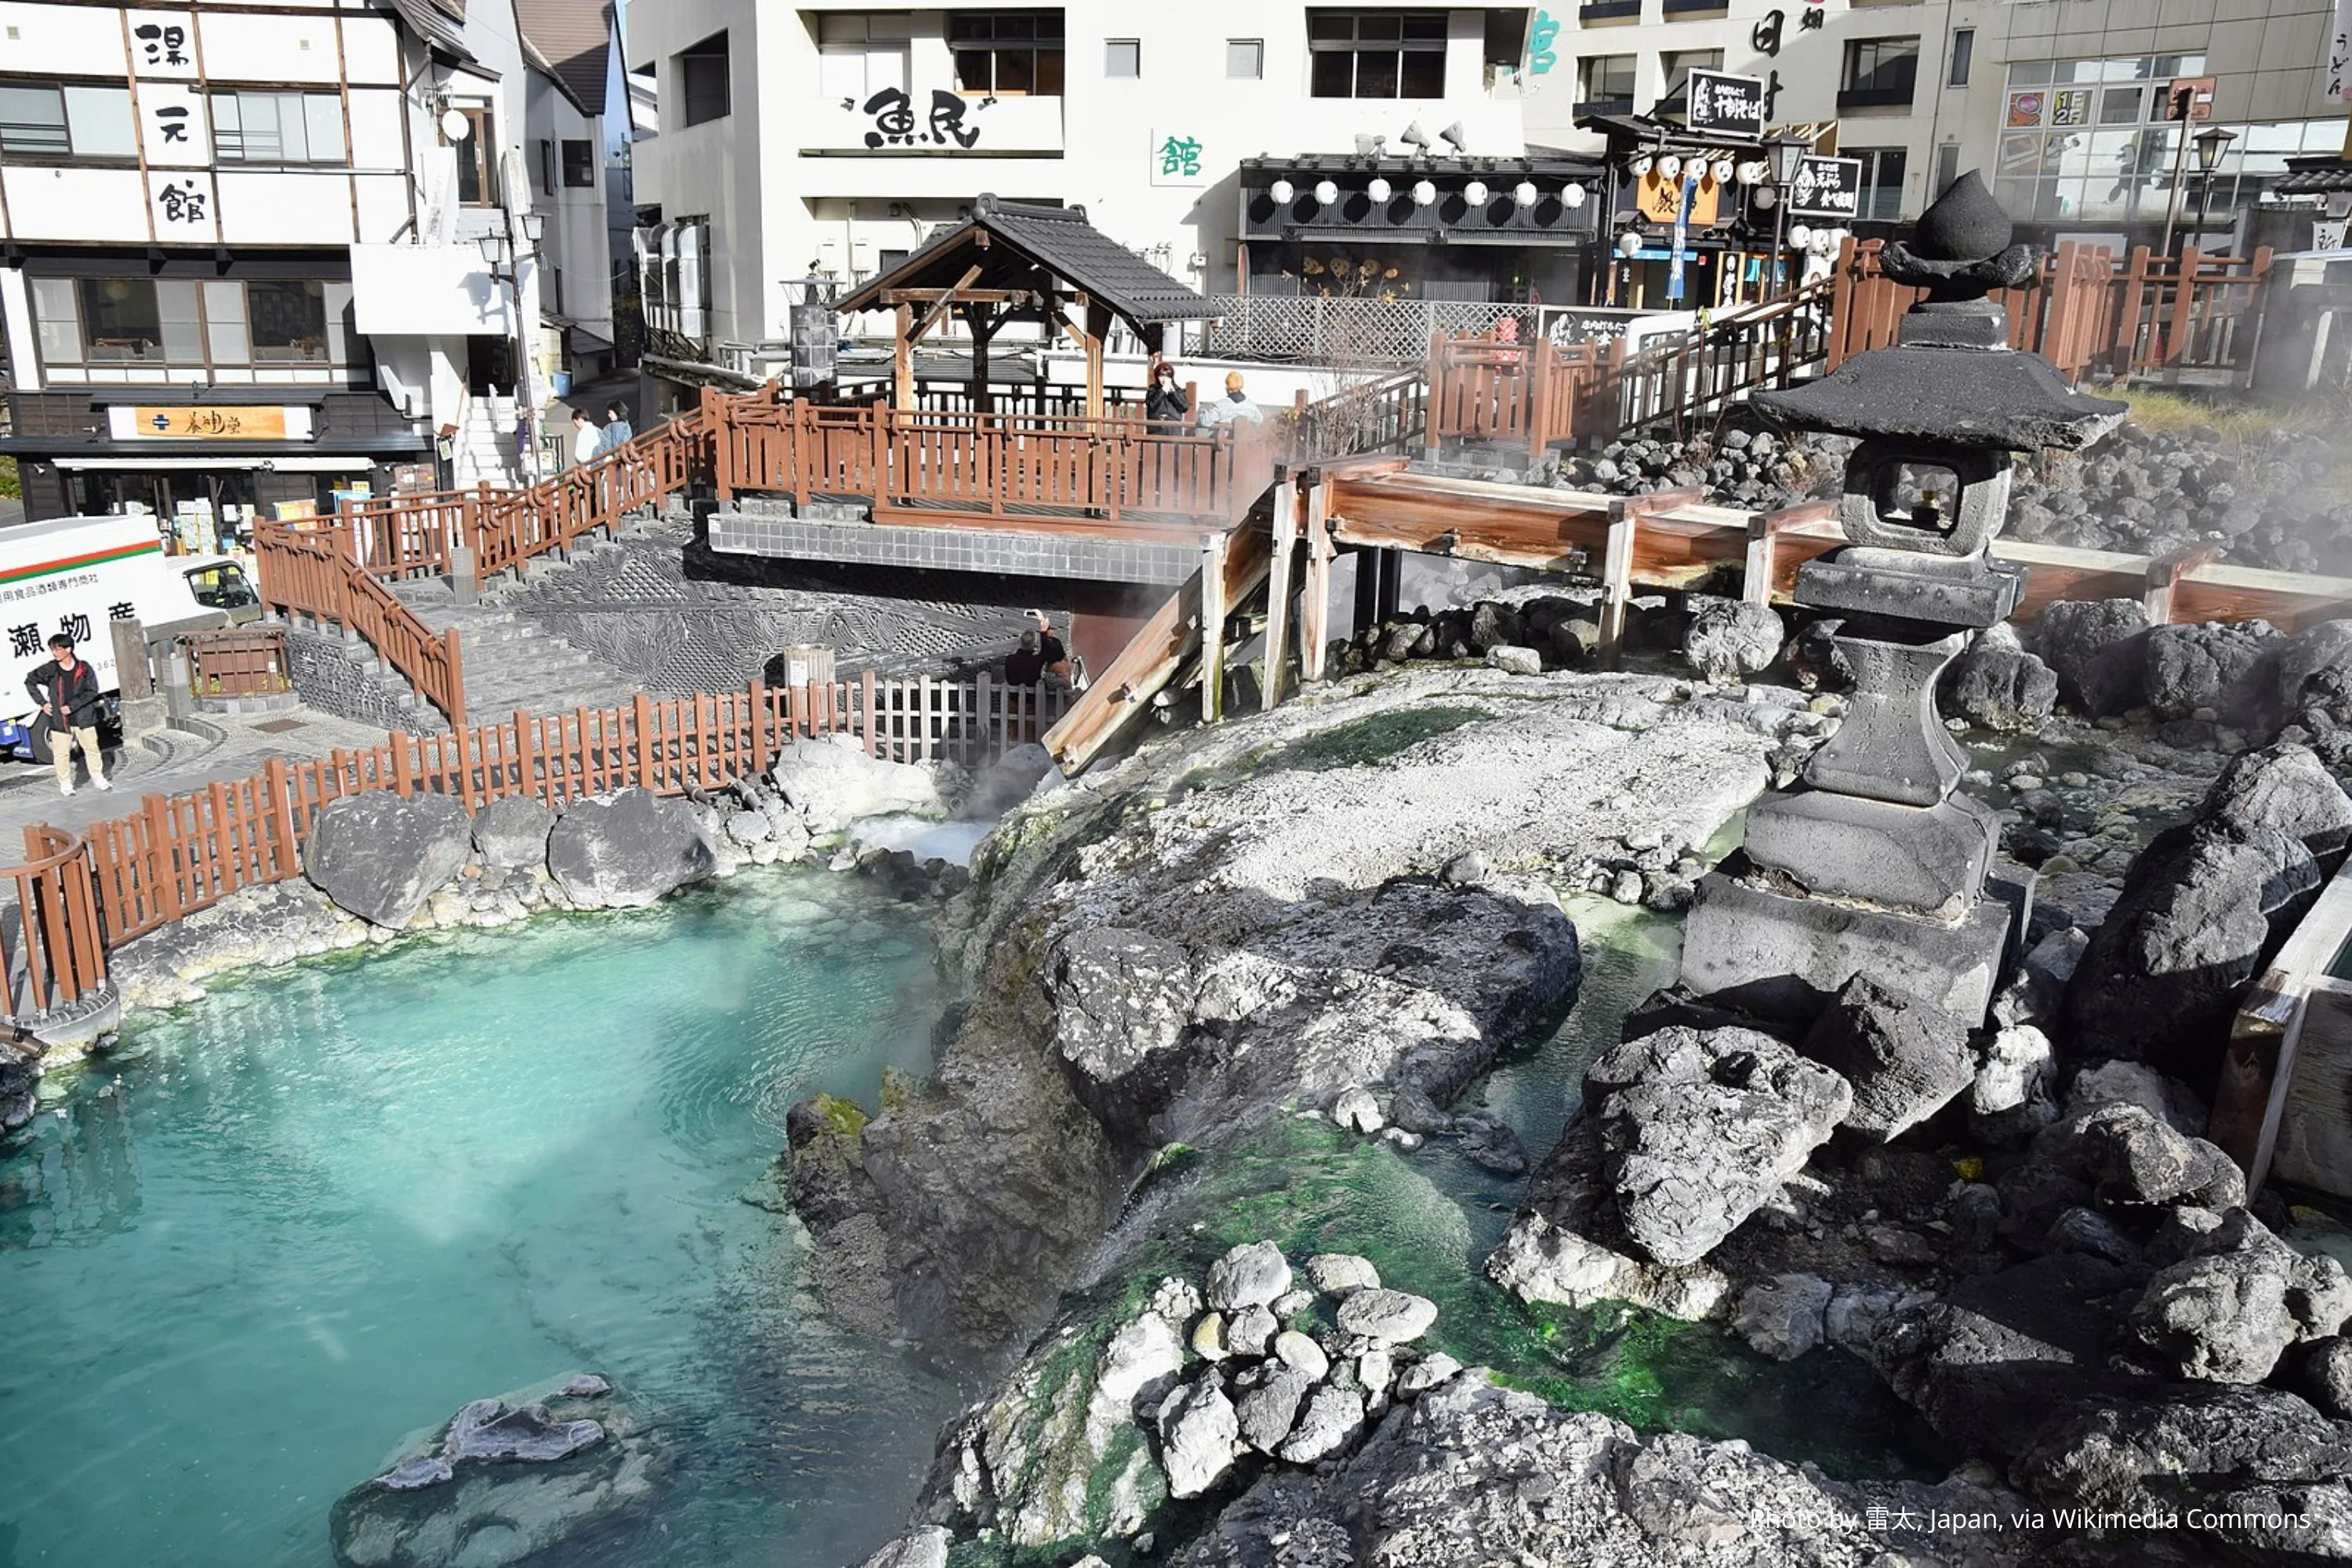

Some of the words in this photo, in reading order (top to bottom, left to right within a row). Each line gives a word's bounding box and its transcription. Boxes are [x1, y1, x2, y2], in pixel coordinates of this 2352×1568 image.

[2328, 33, 2350, 95] うどん
[134, 24, 205, 223] 湯元館
[863, 87, 980, 149] 魚民
[2054, 108, 2082, 124] 2F
[2059, 92, 2084, 107] 1F
